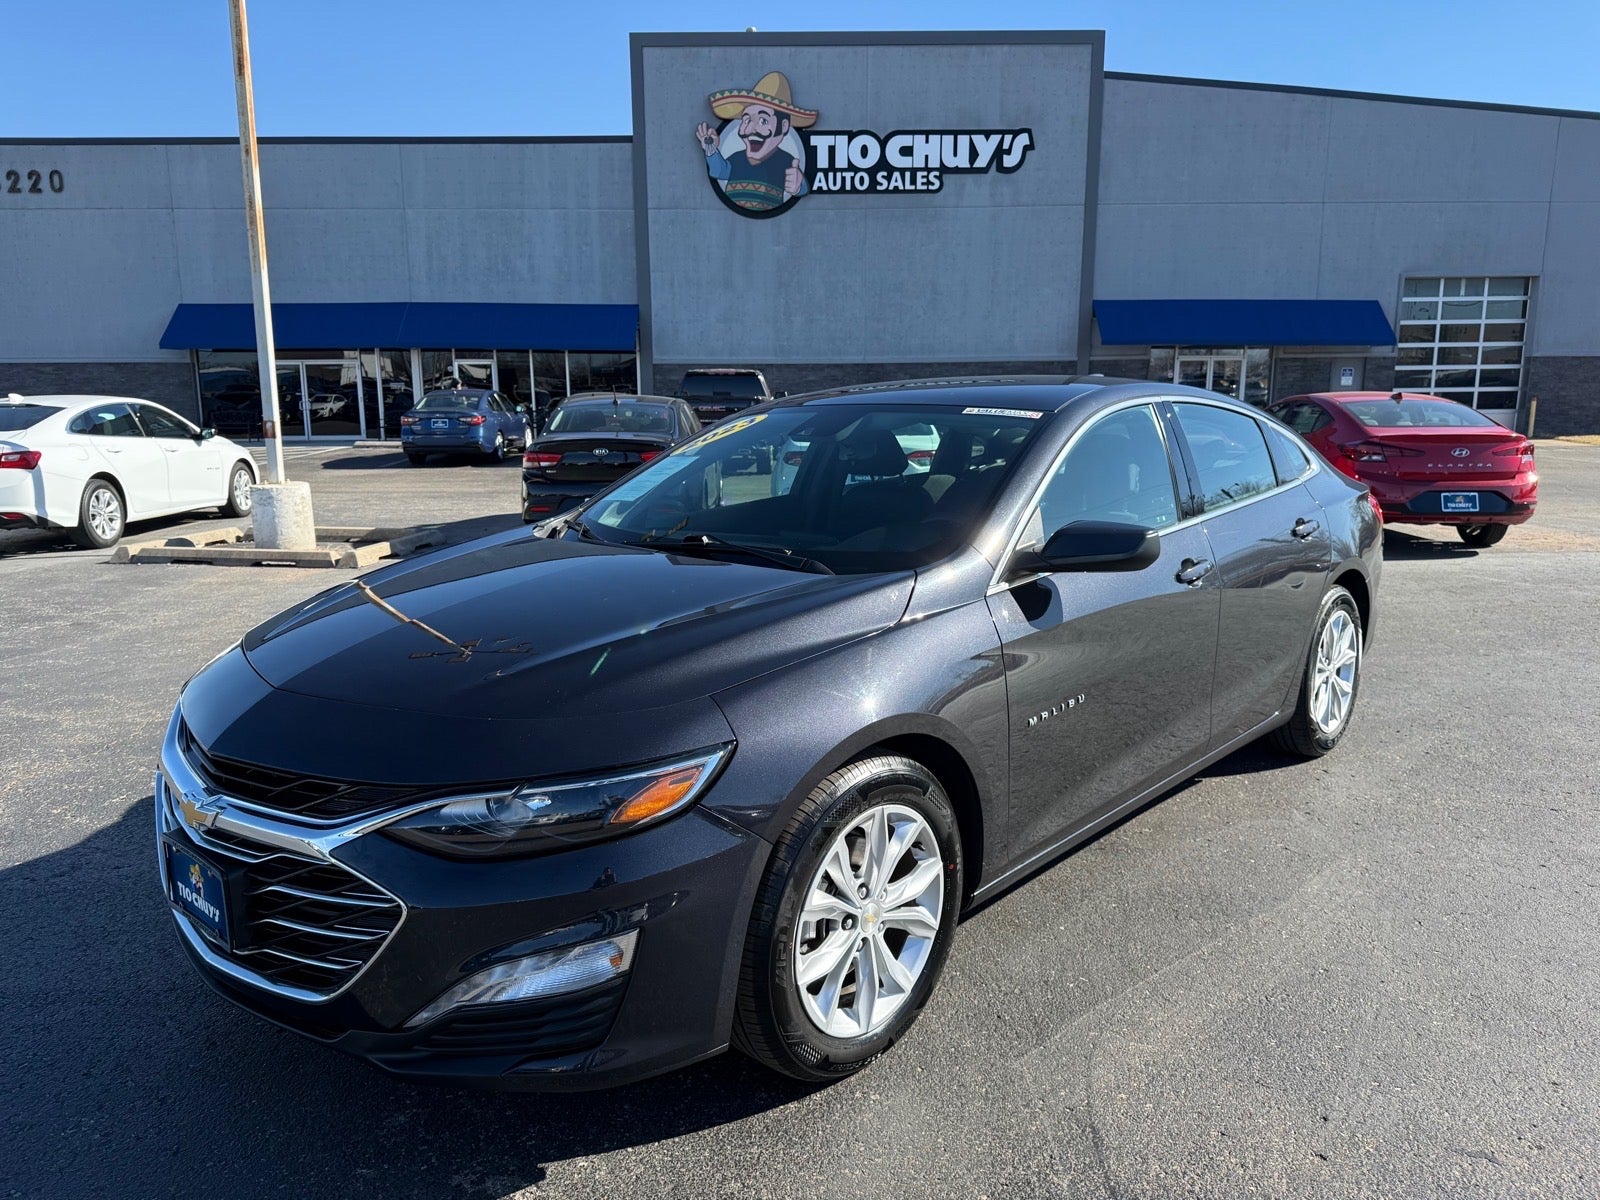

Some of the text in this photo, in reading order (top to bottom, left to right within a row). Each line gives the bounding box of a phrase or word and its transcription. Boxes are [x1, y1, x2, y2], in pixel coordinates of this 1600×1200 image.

[810, 133, 1030, 169] TIO CHUY'S
[0, 169, 64, 194] 220
[812, 171, 941, 191] AUTO SALES
[1027, 693, 1085, 728] MALIBU
[177, 881, 219, 922] TIO CHUY'S
